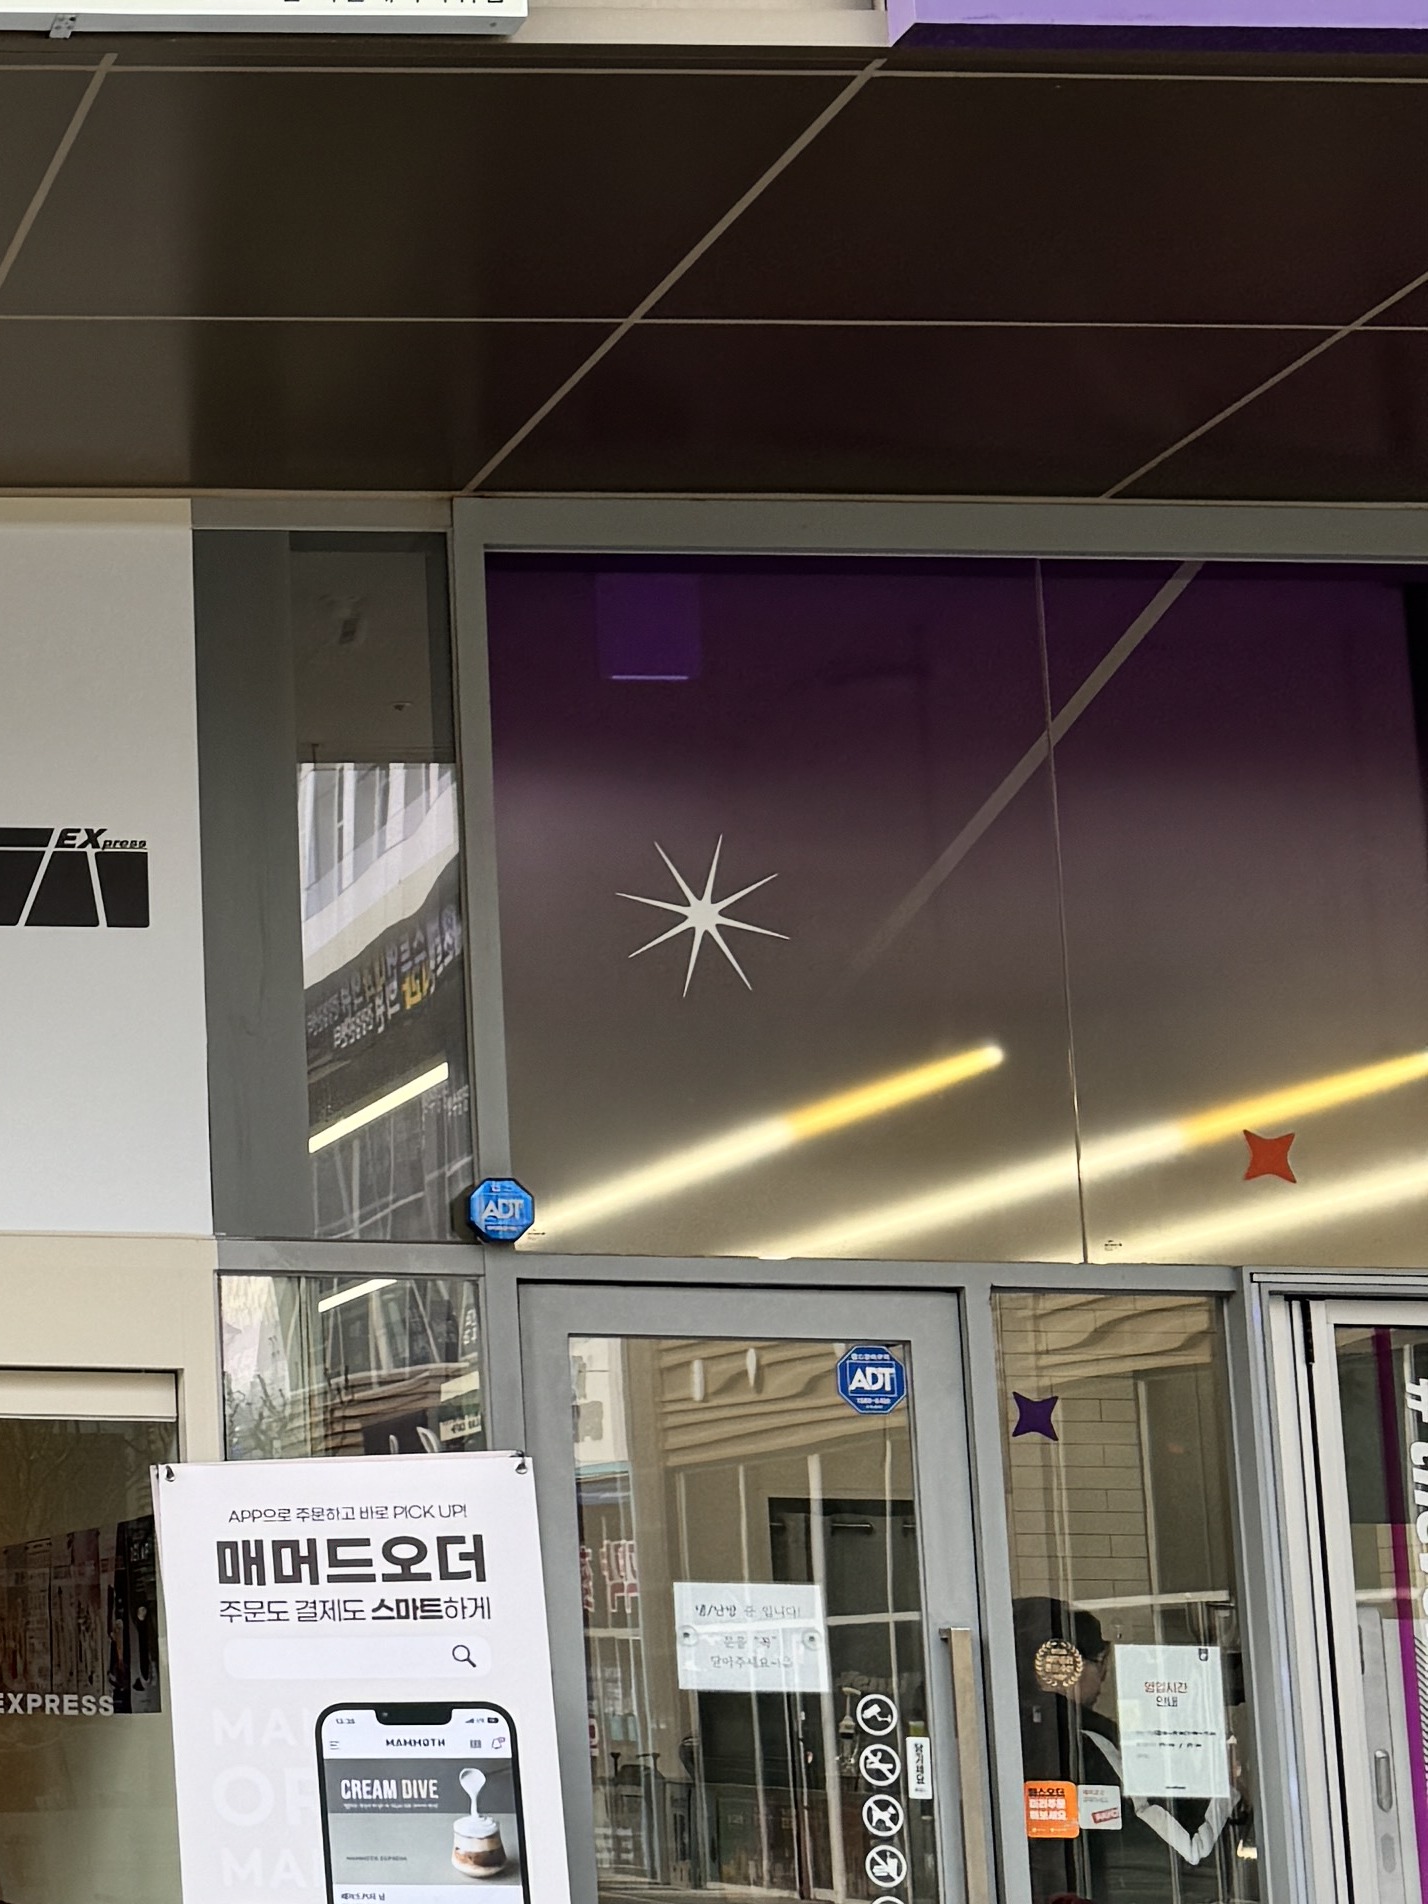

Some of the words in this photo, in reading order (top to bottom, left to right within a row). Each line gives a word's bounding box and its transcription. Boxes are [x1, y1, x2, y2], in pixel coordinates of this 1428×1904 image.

[482, 1198, 524, 1220] ADT
[849, 1367, 895, 1391] ADT
[229, 1508, 291, 1524] APP으로
[296, 1506, 355, 1522] 주문하고
[359, 1505, 389, 1520] 바로
[393, 1504, 434, 1519] PICK
[216, 1534, 487, 1586] 매머드오더
[219, 1599, 289, 1623] 주문도
[295, 1599, 366, 1623] 결제도
[371, 1596, 491, 1622] 스마트하게
[1145, 1681, 1188, 1693] 영업시간
[1156, 1696, 1178, 1707] 안내
[385, 1738, 445, 1748] MAMMOTH
[341, 1779, 398, 1800] CREAM
[402, 1779, 439, 1800] DIVE
